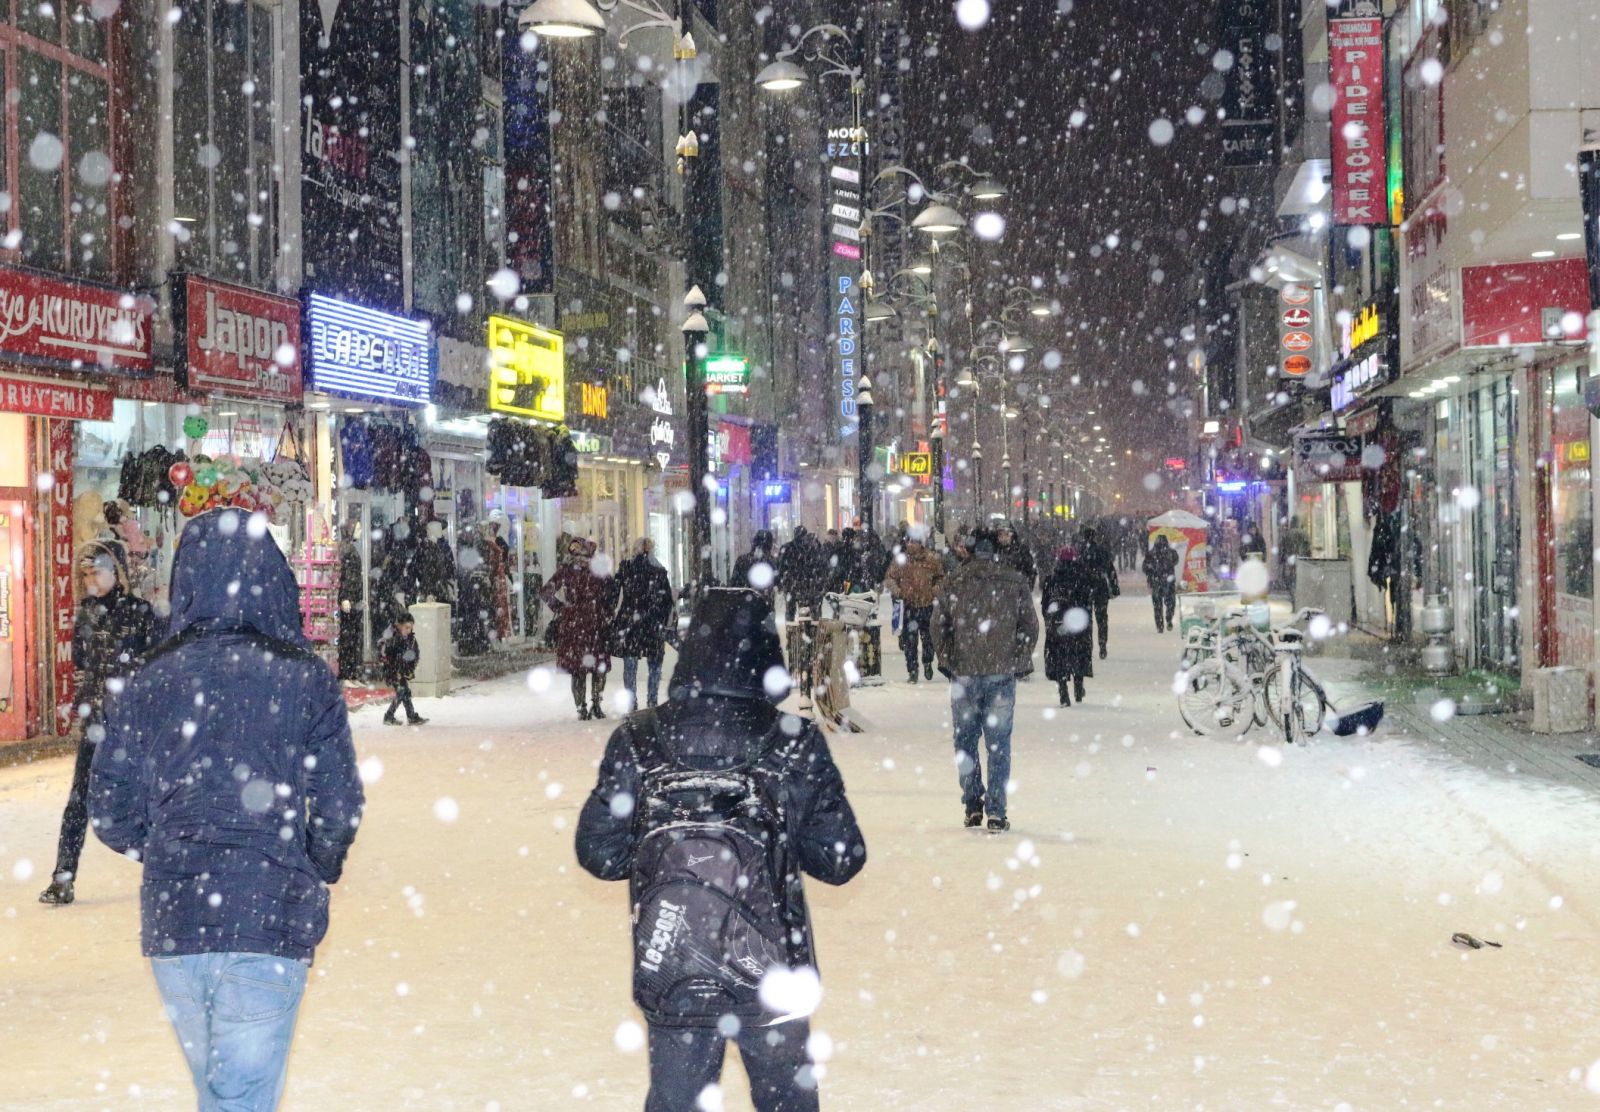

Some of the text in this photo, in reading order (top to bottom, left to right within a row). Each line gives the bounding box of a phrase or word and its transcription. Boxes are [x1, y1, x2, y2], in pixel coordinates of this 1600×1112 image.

[827, 128, 868, 139] MOD
[198, 292, 290, 370] Japon
[838, 277, 857, 417] PARDESÜ
[582, 382, 608, 419] BANKO
[54, 449, 73, 736] KURUYEMİŞ
